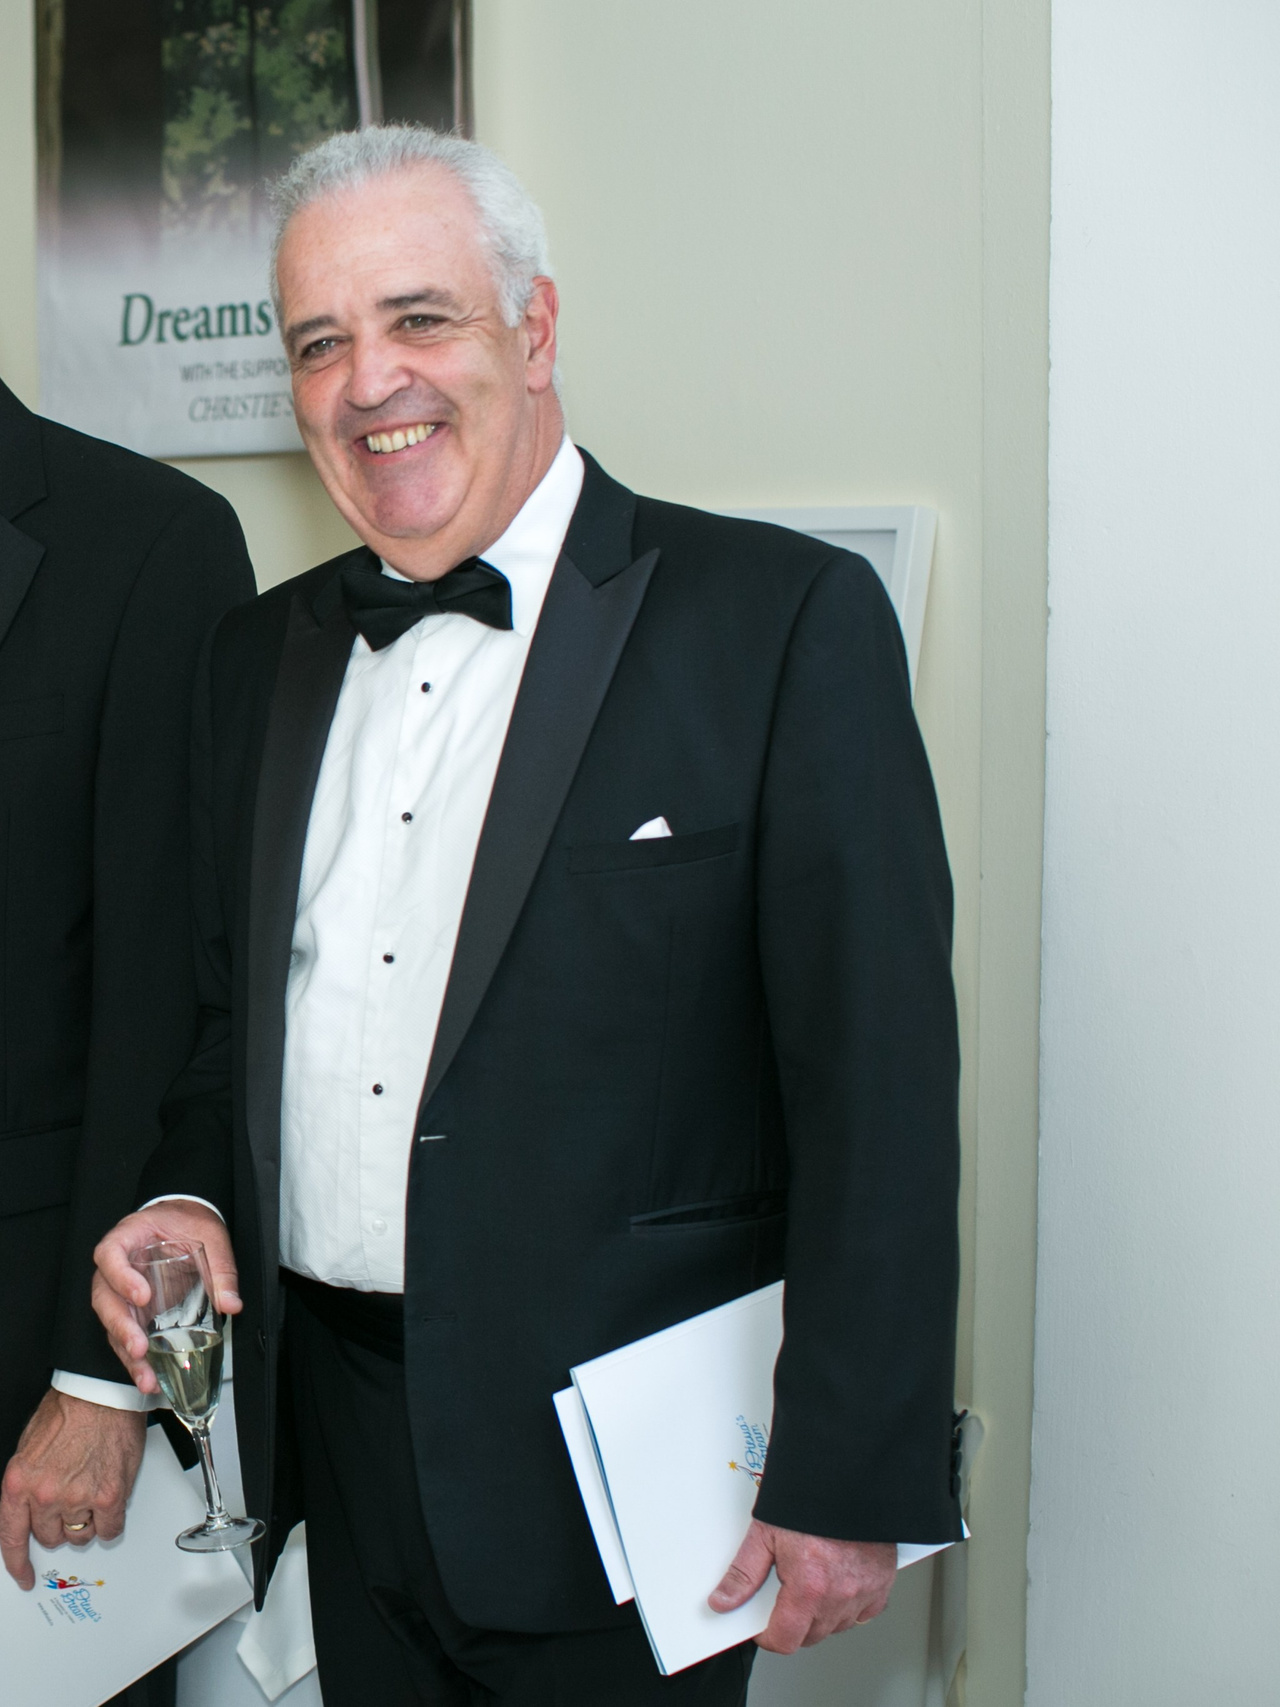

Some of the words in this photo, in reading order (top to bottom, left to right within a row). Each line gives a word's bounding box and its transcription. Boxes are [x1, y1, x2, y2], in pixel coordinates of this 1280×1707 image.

[119, 292, 273, 347] Dreams
[180, 362, 211, 382] WITH
[214, 360, 238, 380] THE
[751, 1423, 768, 1464] ream
